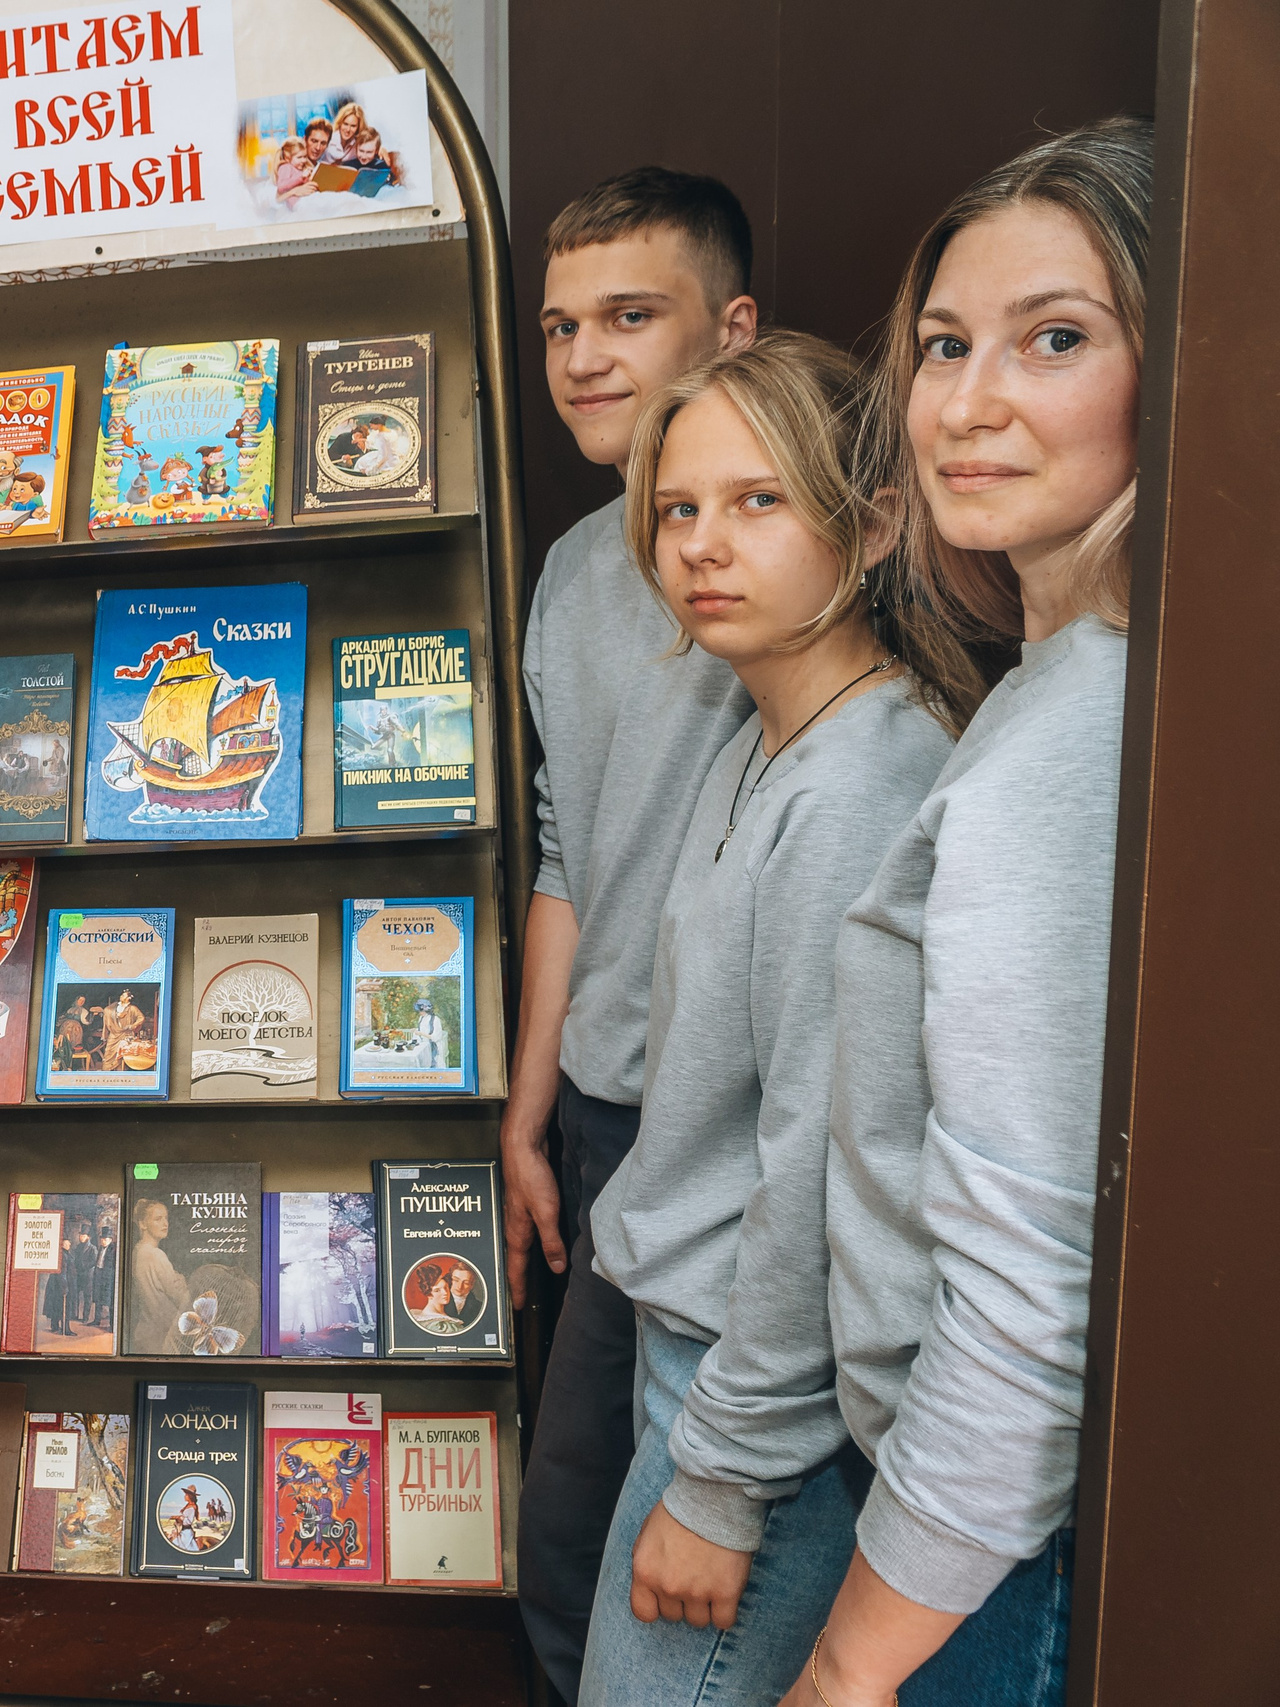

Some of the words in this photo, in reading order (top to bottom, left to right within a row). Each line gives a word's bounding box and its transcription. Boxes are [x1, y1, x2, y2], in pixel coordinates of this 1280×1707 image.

[14, 77, 155, 150] ВСЕЙ
[358, 349, 380, 359] Иван
[324, 356, 414, 375] ТУРГЕНЕВ
[19, 377, 44, 385] ТОЛЬКО
[330, 380, 364, 394] Отцы
[375, 381, 406, 394] дети
[152, 385, 228, 406] РУССКИЕ
[139, 403, 233, 424] НАРОДНЫЕ
[147, 421, 222, 441] СКАЗКИ
[149, 603, 197, 619] Пушкин
[212, 617, 292, 643] Сказки
[341, 638, 394, 655] АРКАДИЙ
[397, 639, 406, 651] И
[409, 635, 445, 650] БОРИС
[340, 647, 465, 690] СТРУГАЦКИЕ
[21, 672, 64, 687] ТОЛСТОЙ
[342, 768, 392, 787] ПИКНИК
[394, 768, 411, 784] НА
[413, 764, 469, 783] ОБОЧИНЕ
[382, 923, 435, 935] ЧЕХОВ
[68, 930, 154, 944] ОСТРОВСКИЙ
[209, 933, 254, 945] ВАЛЕРИЙ
[258, 932, 309, 943] КУЗНЕЦОВ
[98, 957, 122, 965] Пьесы
[221, 1011, 289, 1024] ПОСЕЛОК
[198, 1027, 247, 1041] МОЕГО
[254, 1026, 313, 1040] ДЕТСТВА
[170, 1193, 248, 1205] ТАТЬЯНА
[400, 1195, 481, 1213] ПУШКИН
[191, 1206, 248, 1219] КУЛИК
[24, 1220, 52, 1229] ЗОЛОТОЙ
[31, 1231, 44, 1239] ВЕК
[207, 1234, 248, 1247] пирог
[403, 1229, 442, 1239] Евгений
[444, 1228, 481, 1238] Онегин
[23, 1240, 51, 1249] РУССКОЙ
[190, 1244, 248, 1253] счастья
[24, 1251, 49, 1259] ПОЭЗИИ
[160, 1413, 237, 1431] ЛОНДОН
[399, 1431, 412, 1443] М.
[414, 1431, 424, 1443] А.
[426, 1430, 480, 1443] БУЛГАКОВ
[45, 1446, 68, 1456] КРЫЛОВ
[157, 1446, 205, 1464] Сердца
[208, 1451, 238, 1465] трех
[46, 1468, 65, 1478] Басни
[399, 1447, 481, 1493] ДНИ
[399, 1494, 483, 1512] ТУРБИНЫХ
